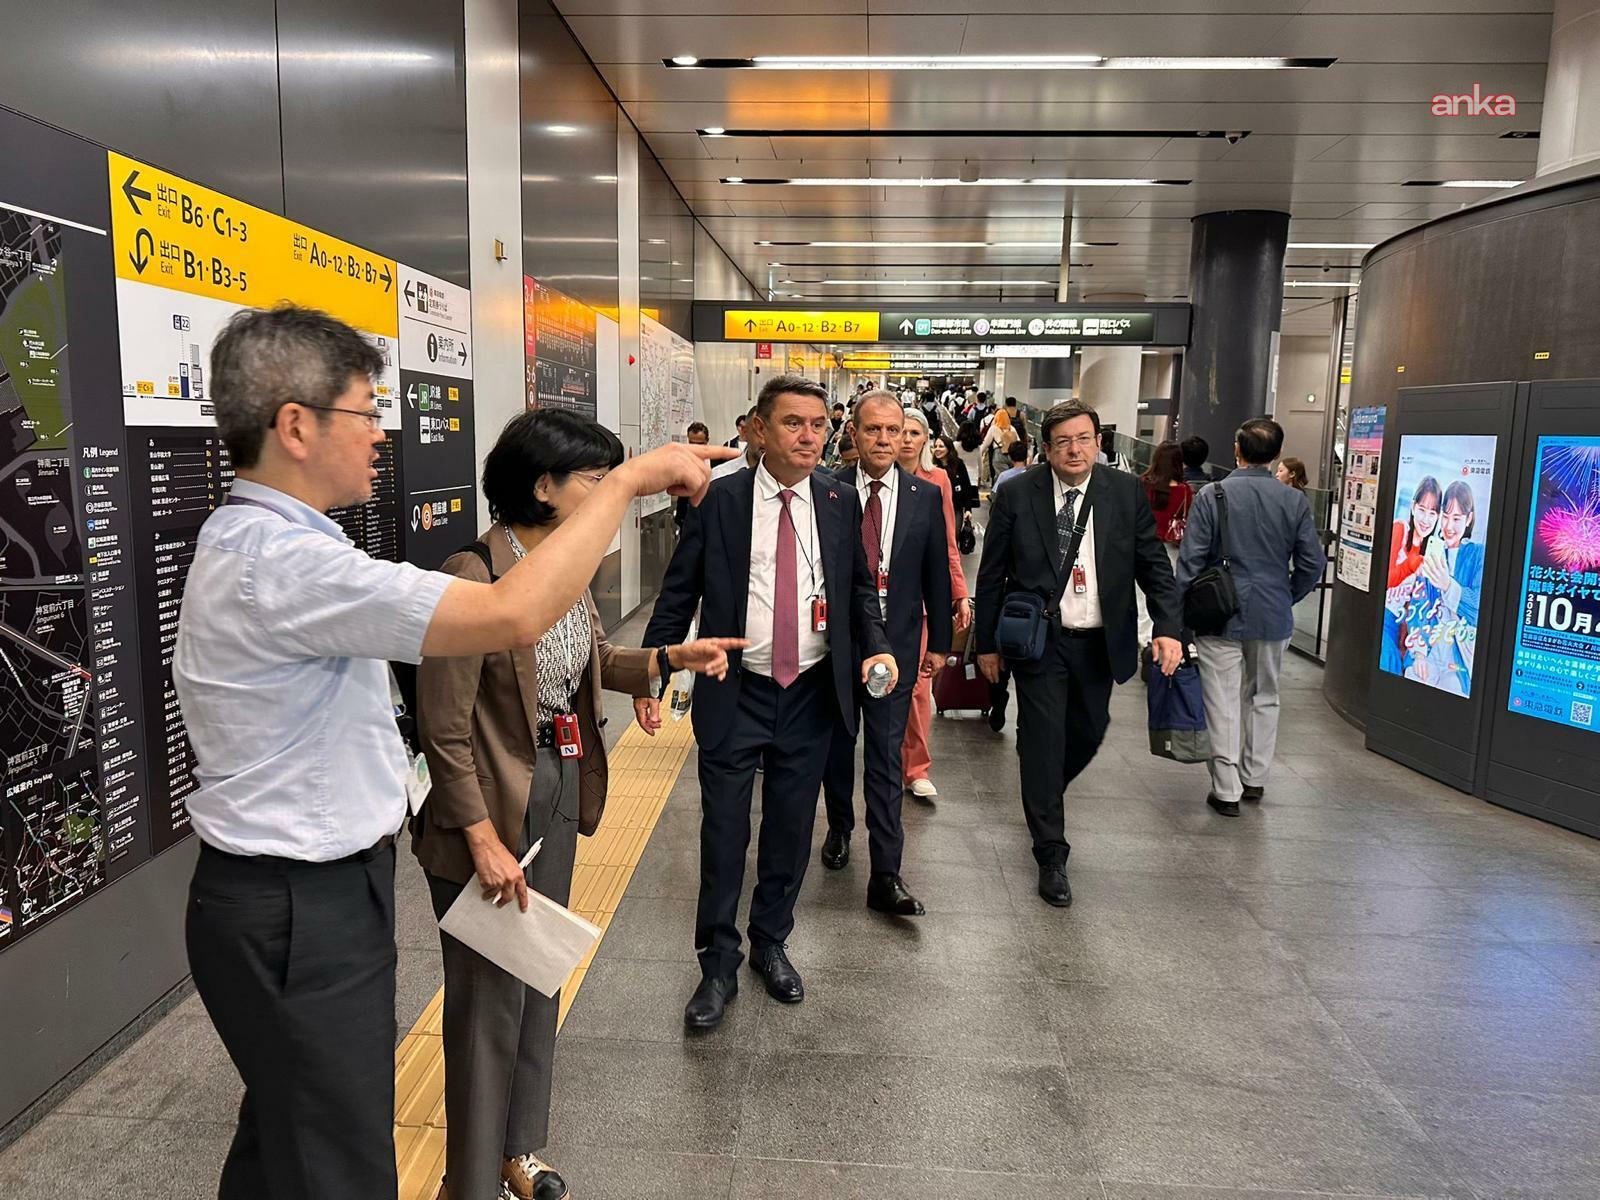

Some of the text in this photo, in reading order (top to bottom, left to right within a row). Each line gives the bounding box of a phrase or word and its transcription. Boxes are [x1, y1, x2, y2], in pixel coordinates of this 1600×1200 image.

[157, 183, 178, 206] 出口
[158, 204, 171, 219] Exit
[294, 232, 307, 250] 出口
[160, 240, 180, 262] 出口
[294, 250, 302, 262] Exit
[160, 262, 174, 275] Exit
[100, 448, 118, 457] Legend
[1530, 566, 1600, 586] 花火大会開
[1525, 594, 1534, 625] 2025
